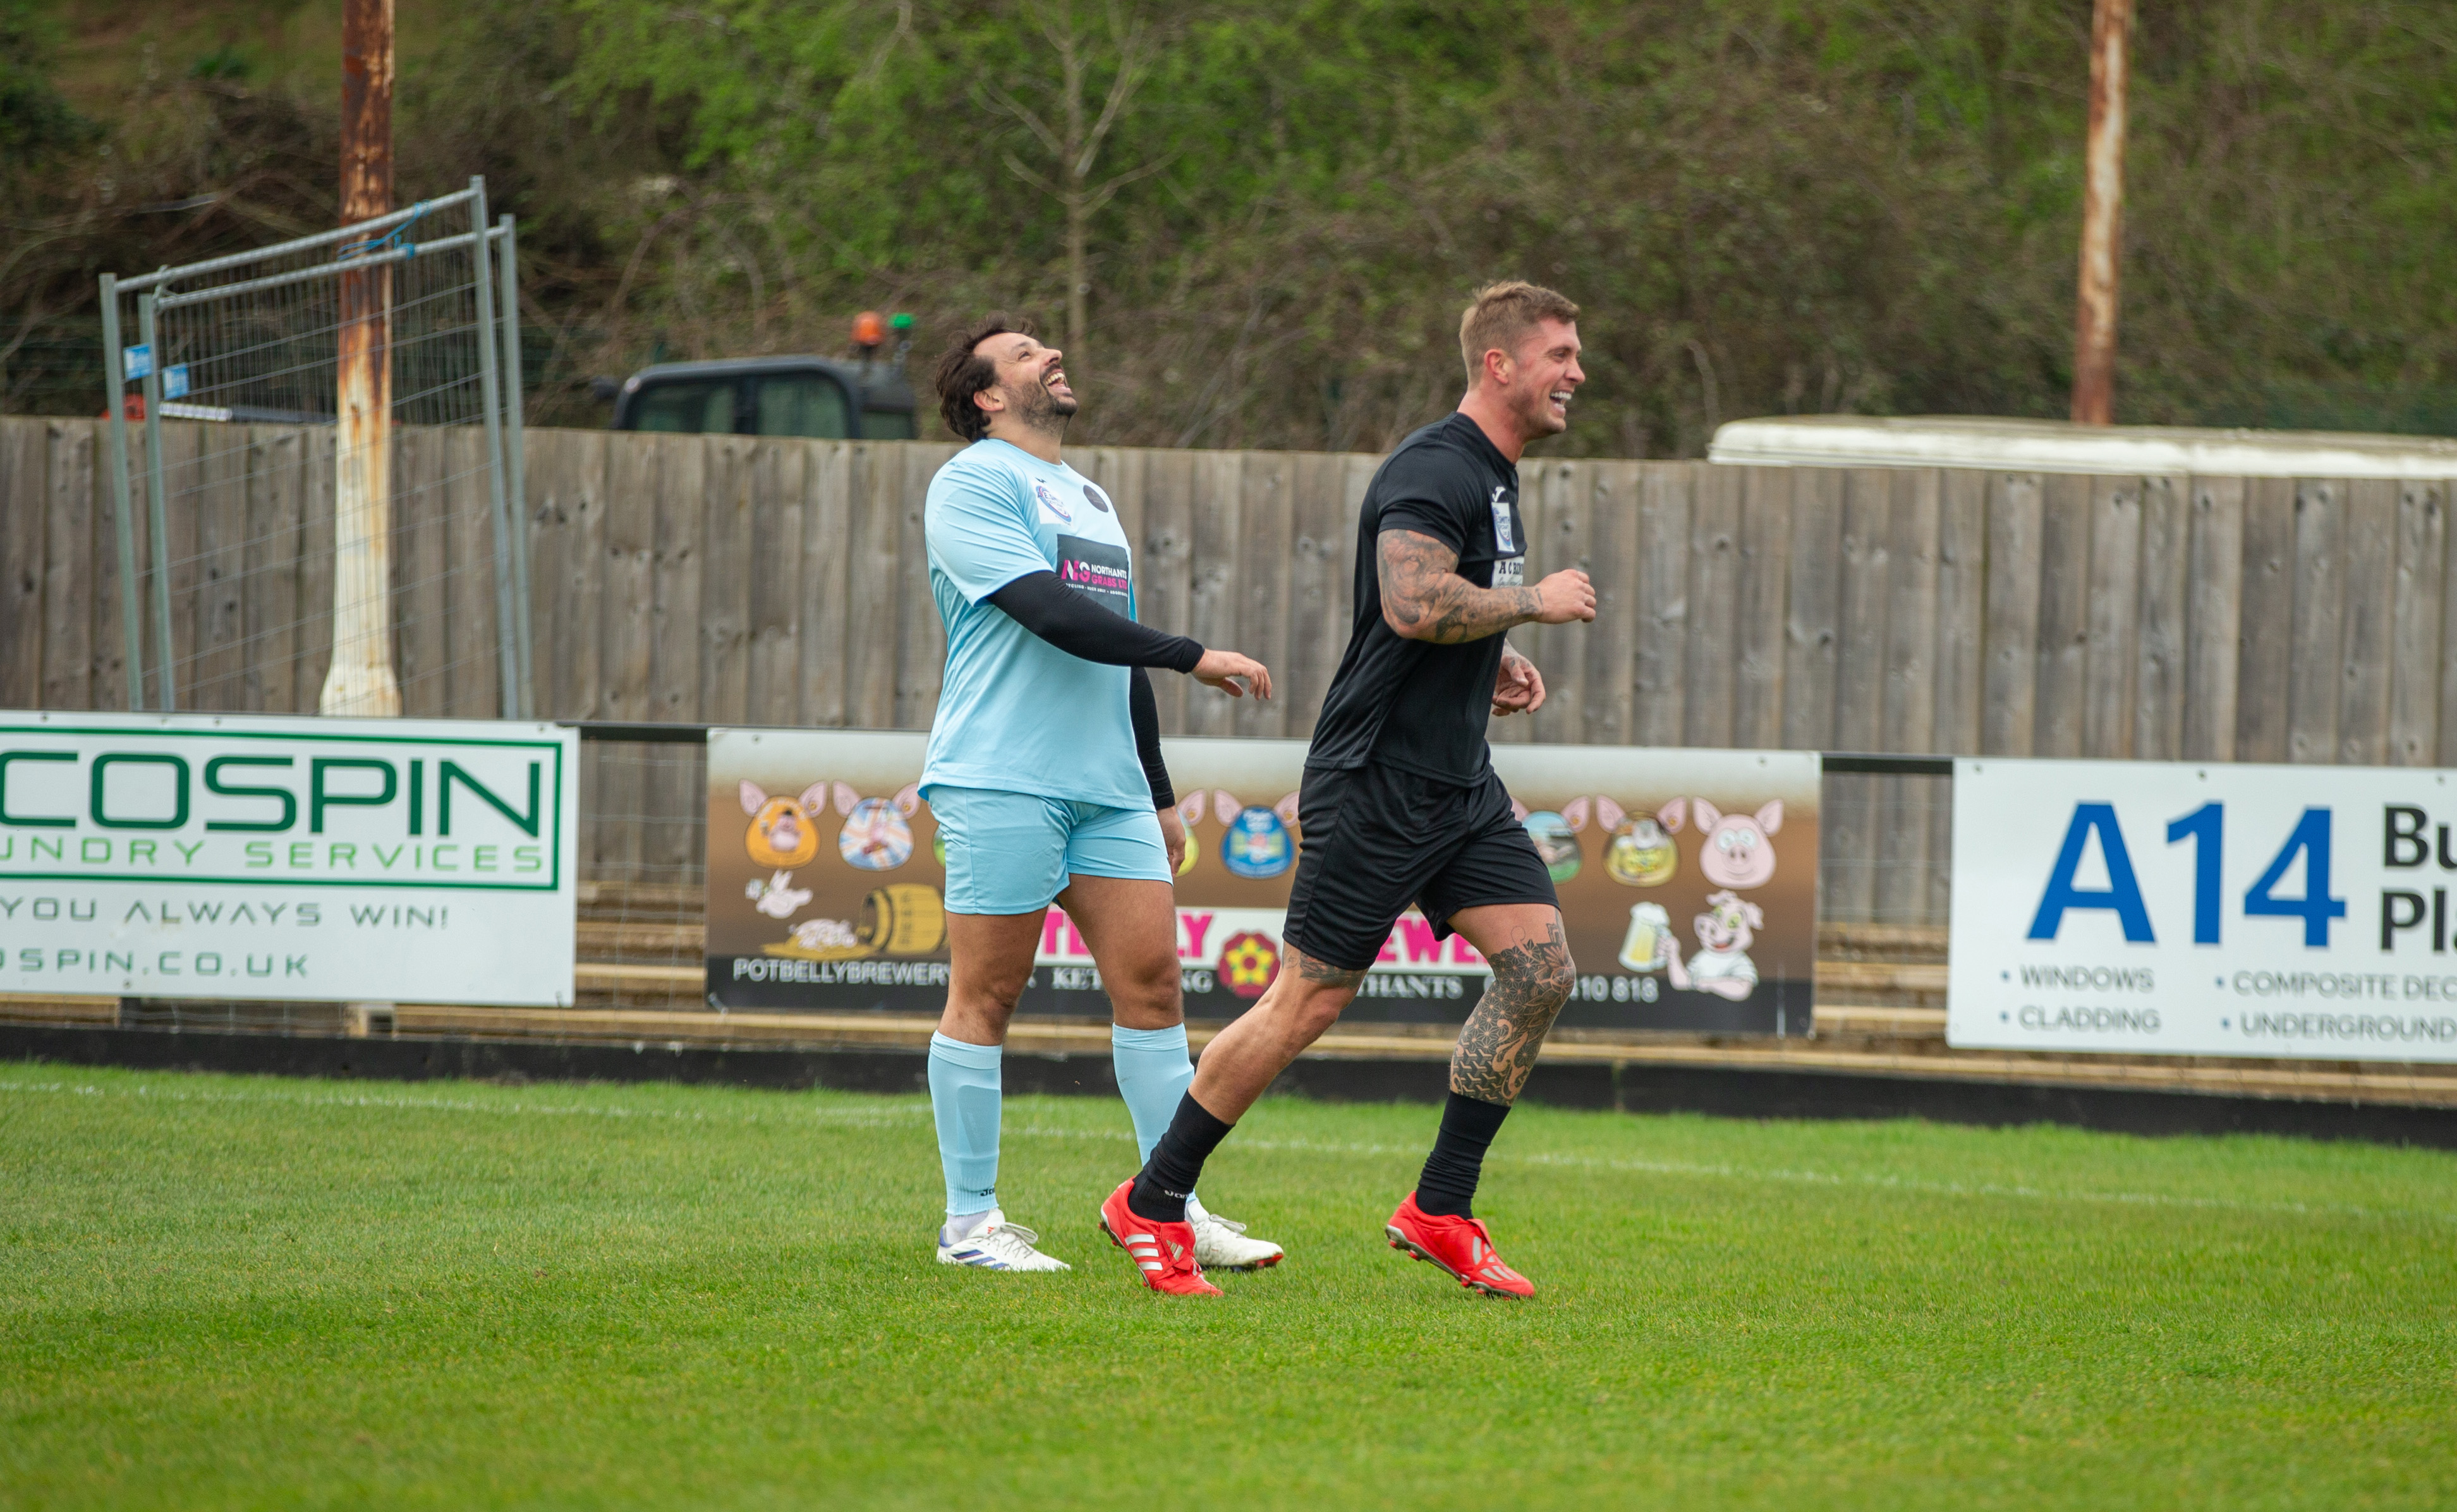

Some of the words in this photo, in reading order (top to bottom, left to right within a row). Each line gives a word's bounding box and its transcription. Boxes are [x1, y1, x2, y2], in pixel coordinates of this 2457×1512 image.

[1091, 564, 1127, 579] NORTHANTS
[1091, 574, 1117, 588] GRABS
[1117, 578, 1127, 591] LTD
[1498, 560, 1507, 574] A
[1508, 561, 1512, 574] C
[0, 750, 542, 839] COSPIN
[245, 841, 544, 873] SERVICES
[2025, 799, 2348, 949] A14
[0, 896, 97, 922] YOU
[124, 900, 323, 927] ALWAYS
[350, 904, 451, 930] WIN!
[2379, 885, 2457, 953] Pl
[0, 947, 310, 979] SPIN.CO.UK
[2020, 964, 2155, 993] WINDOWS
[1612, 975, 1659, 1003] 818
[2233, 970, 2398, 1000] COMPOSITE
[2403, 974, 2457, 1002] DEC
[2019, 1005, 2162, 1033] CLADDING
[2240, 1012, 2457, 1043] UNDERGROUND
